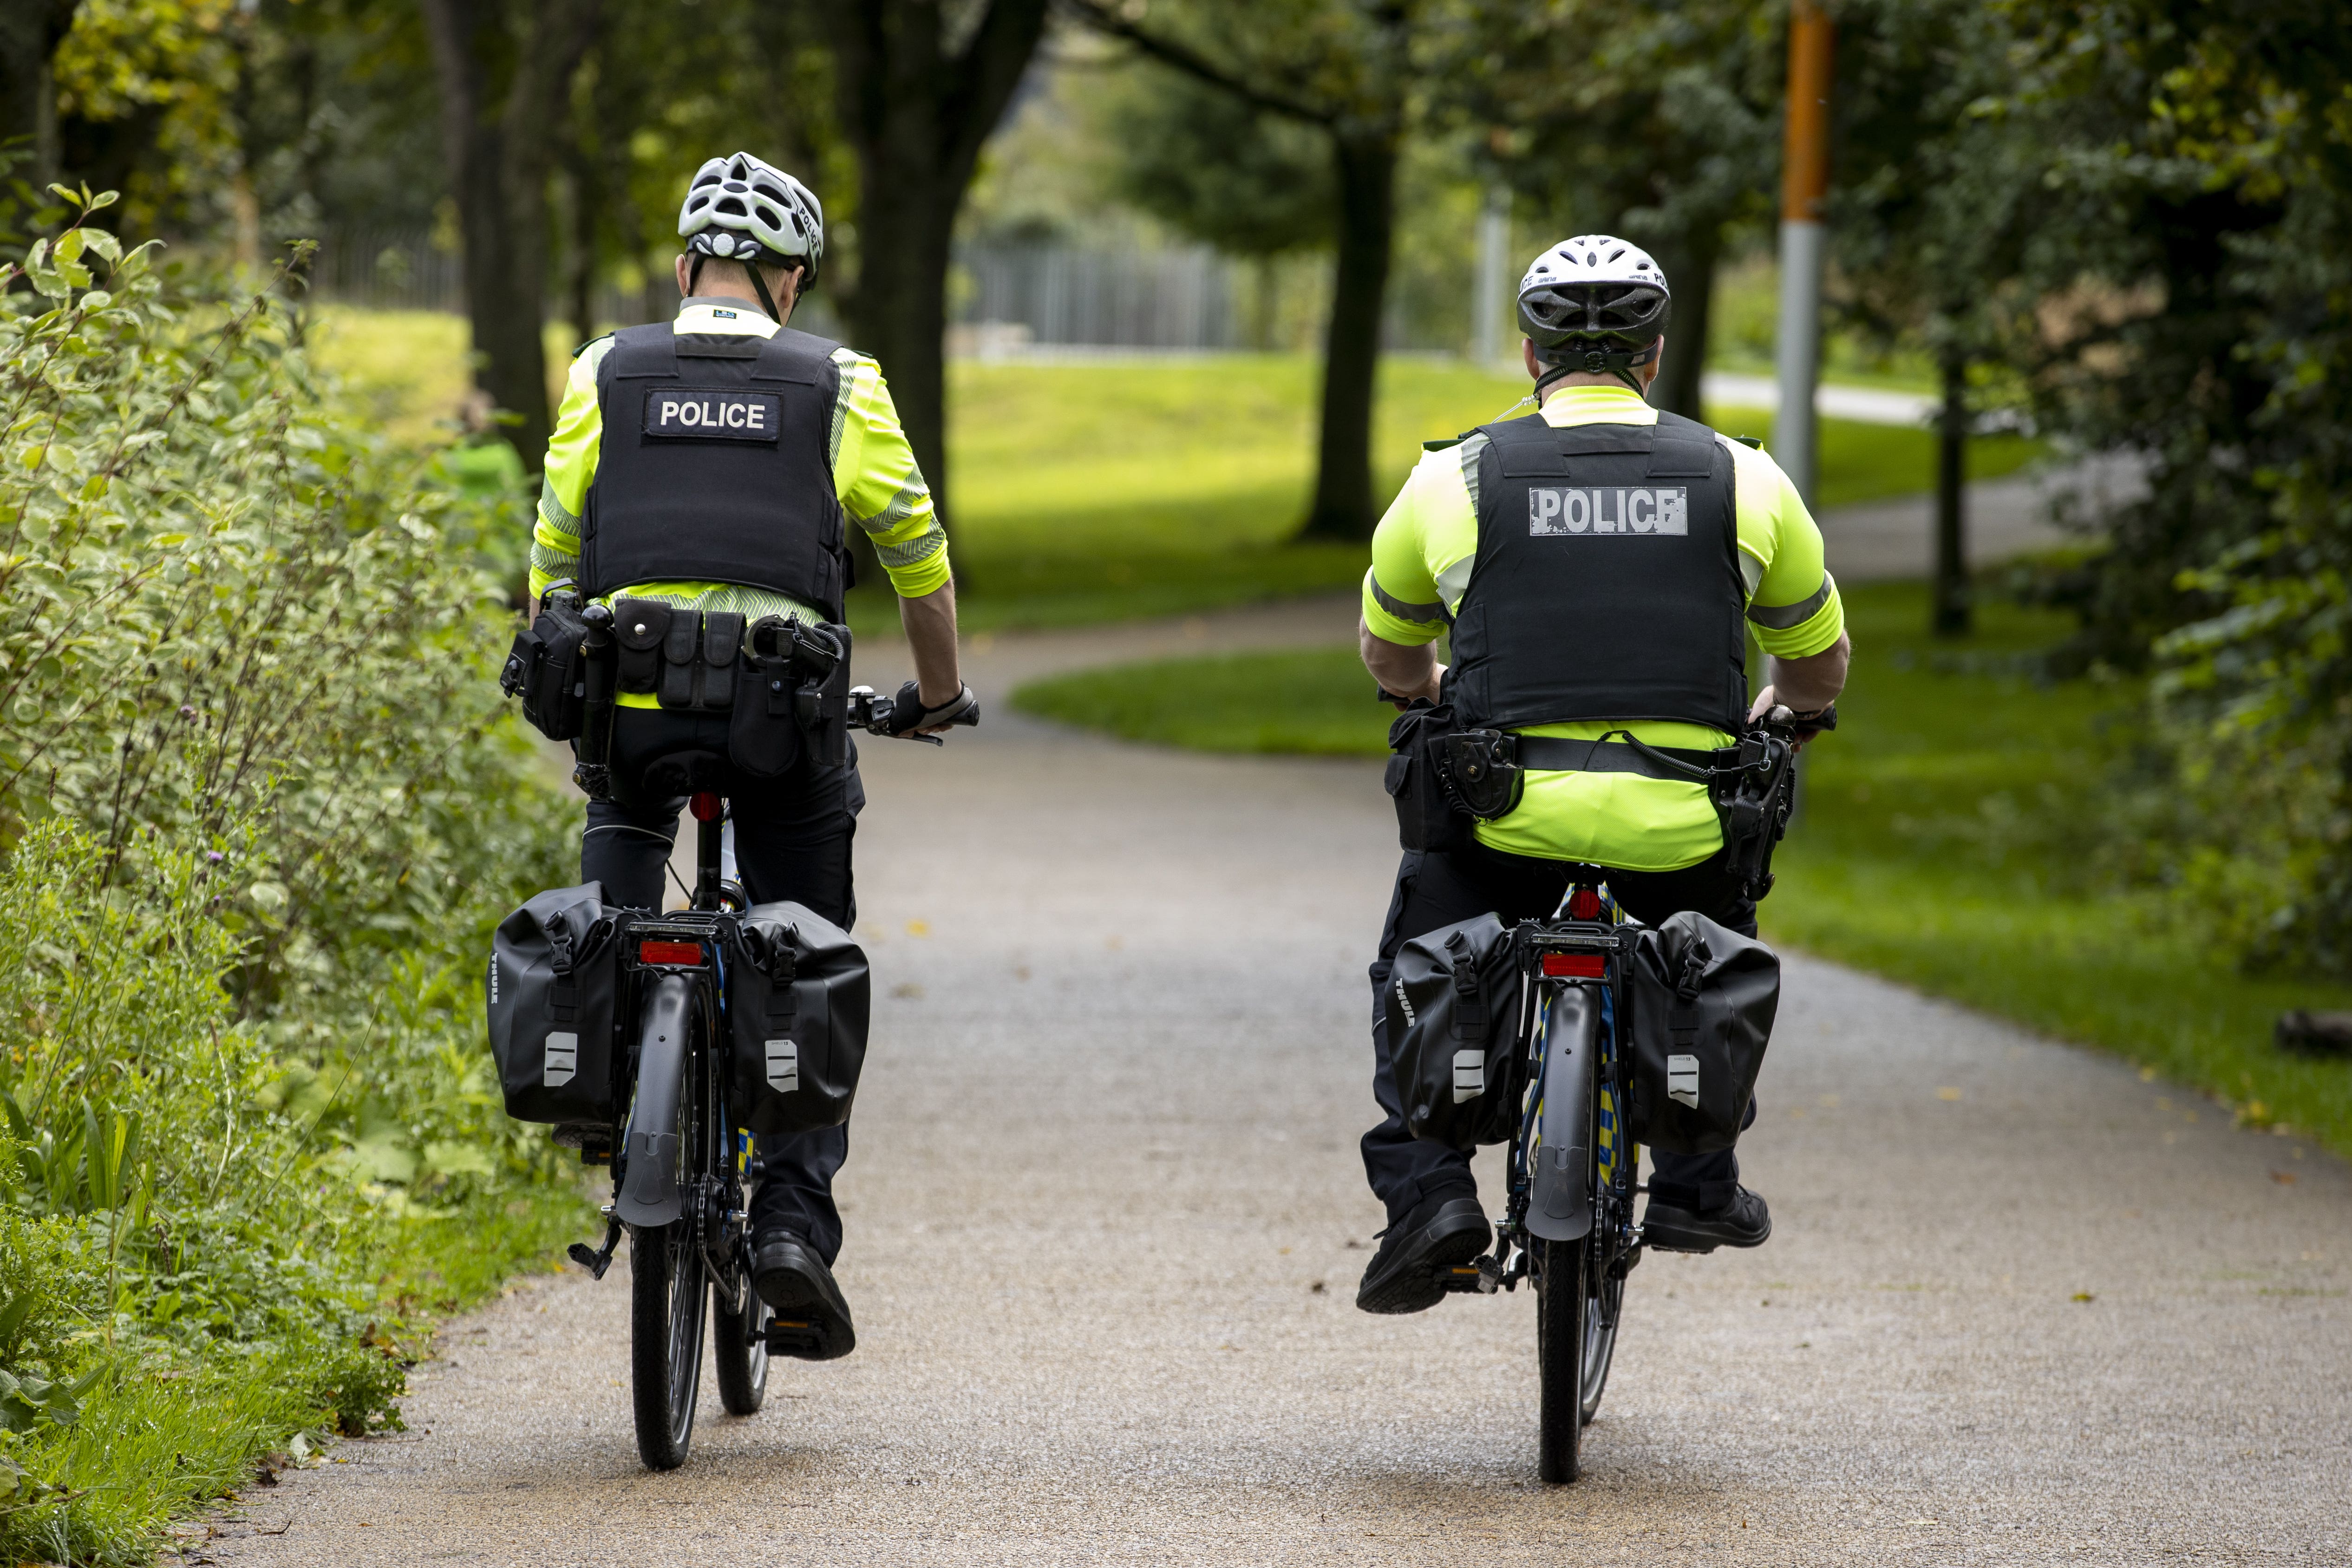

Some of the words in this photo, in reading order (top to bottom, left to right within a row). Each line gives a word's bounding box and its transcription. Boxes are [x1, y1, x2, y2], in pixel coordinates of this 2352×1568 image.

[799, 207, 818, 251] POLICE
[1653, 273, 1670, 292] POL
[660, 401, 765, 429] POLICE
[1538, 489, 1679, 533] POLICE
[1396, 978, 1415, 1027] THULE
